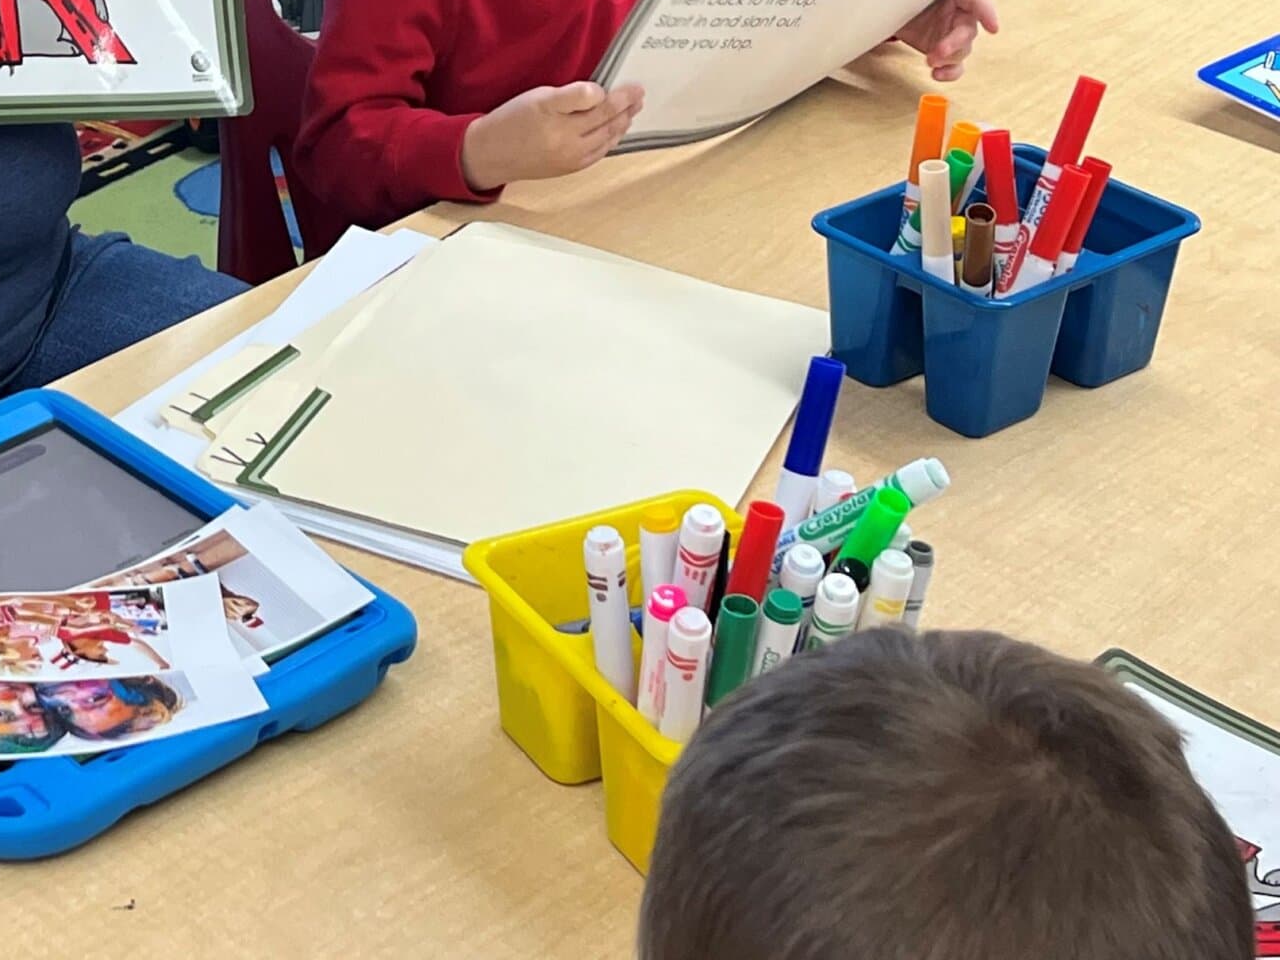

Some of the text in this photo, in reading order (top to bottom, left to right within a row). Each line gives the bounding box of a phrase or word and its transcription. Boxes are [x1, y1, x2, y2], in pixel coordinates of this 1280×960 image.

[655, 13, 694, 28] Slant
[693, 14, 708, 28] in
[709, 14, 740, 28] and
[741, 14, 776, 28] slant
[641, 35, 690, 50] Before
[690, 38, 719, 52] you
[802, 491, 871, 534] Crayola
